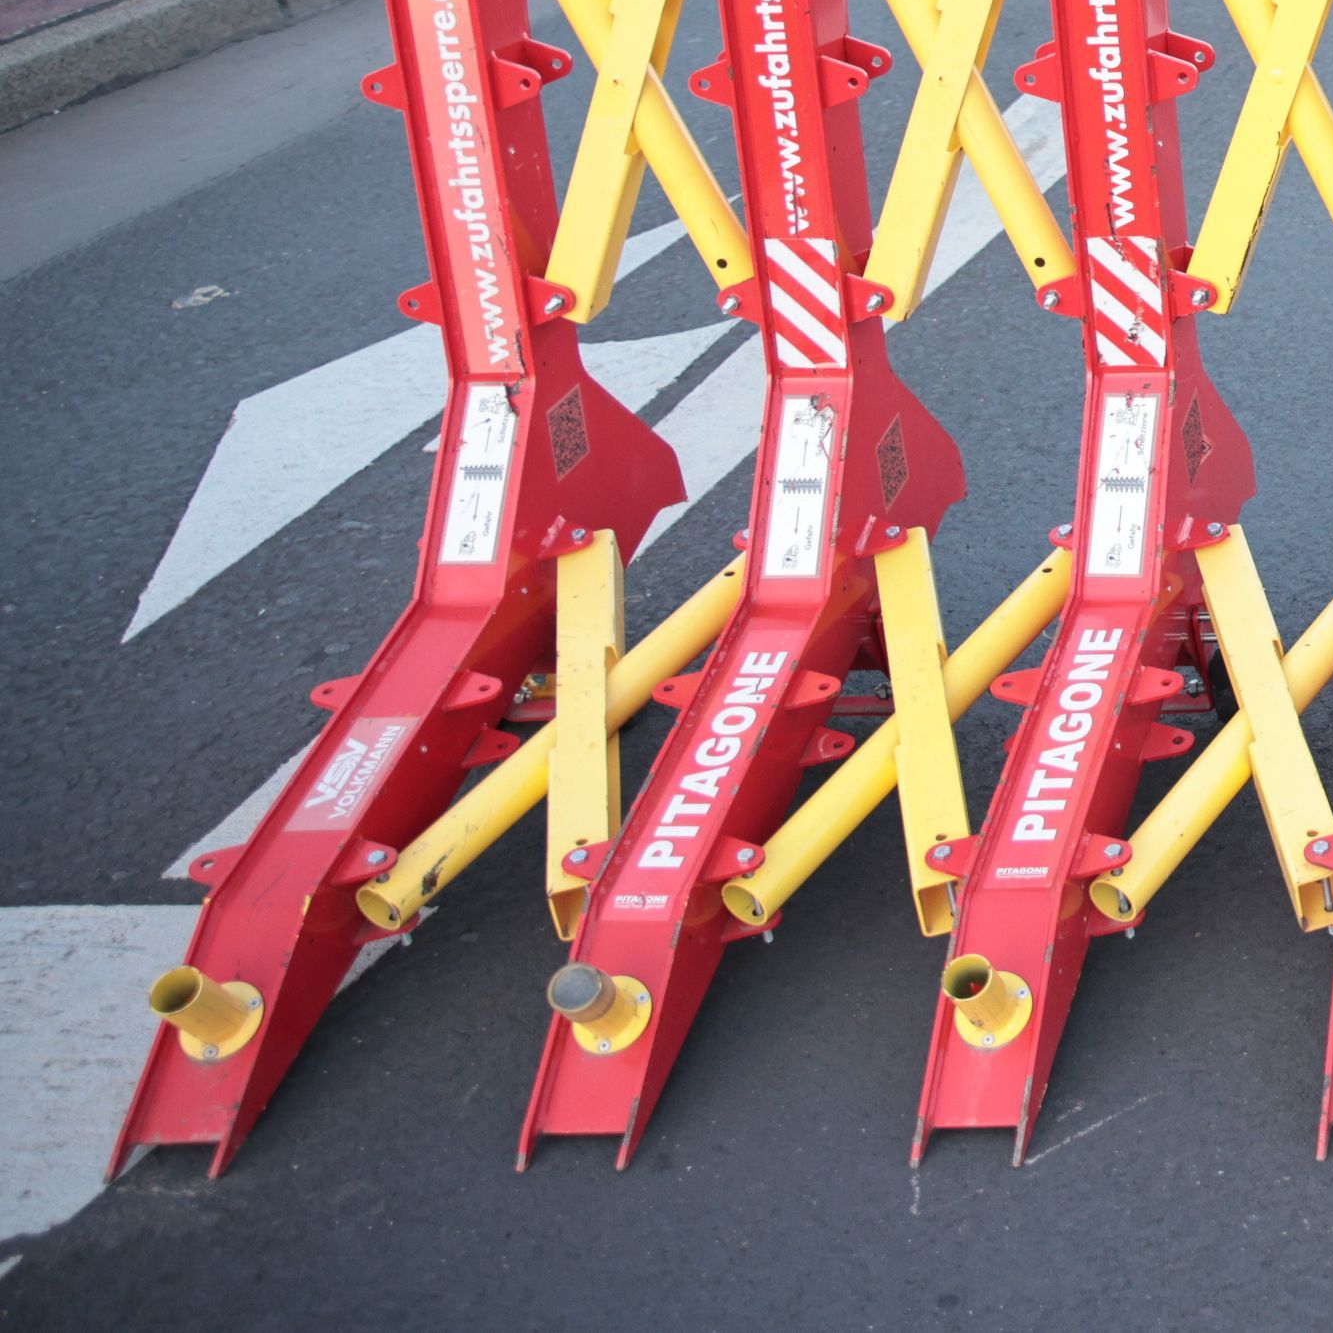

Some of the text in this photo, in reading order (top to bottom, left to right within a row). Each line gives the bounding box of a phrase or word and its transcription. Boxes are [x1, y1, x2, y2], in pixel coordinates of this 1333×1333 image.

[328, 725, 406, 820] VOLKMANN
[637, 649, 788, 868] PITAGONE
[1012, 628, 1123, 841] PITAGONE
[996, 866, 1049, 875] PITAGONE
